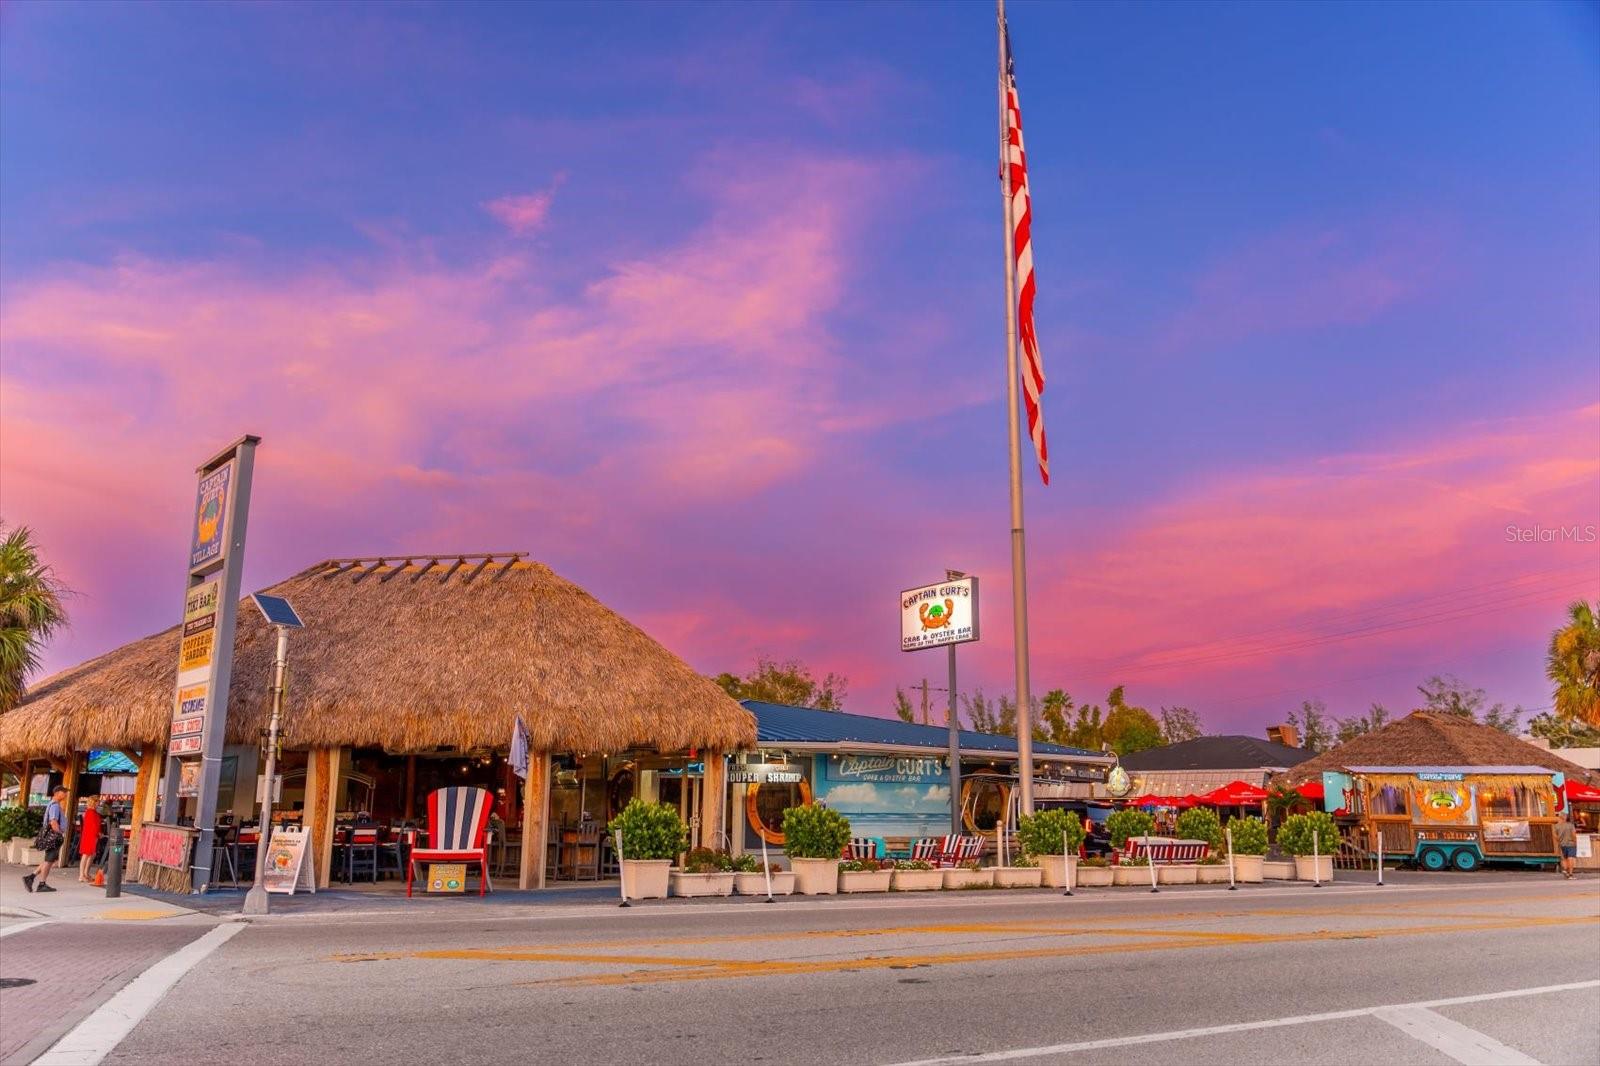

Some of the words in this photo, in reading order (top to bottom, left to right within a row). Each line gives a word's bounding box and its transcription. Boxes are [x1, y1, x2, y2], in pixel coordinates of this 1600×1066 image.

[200, 468, 229, 495] CAPTAIN
[192, 541, 219, 565] VILLAGE
[199, 594, 211, 609] BAR
[903, 589, 937, 609] CAPTAIN
[939, 586, 969, 597] CURT'S
[183, 635, 205, 651] COFFEE
[903, 635, 921, 643] CRAB
[930, 629, 956, 639] OYSTER
[957, 626, 972, 635] BAR
[185, 647, 207, 661] GARDEN
[840, 757, 895, 777] Captain
[896, 758, 943, 776] CURT'S
[767, 773, 802, 783] SHRIMP
